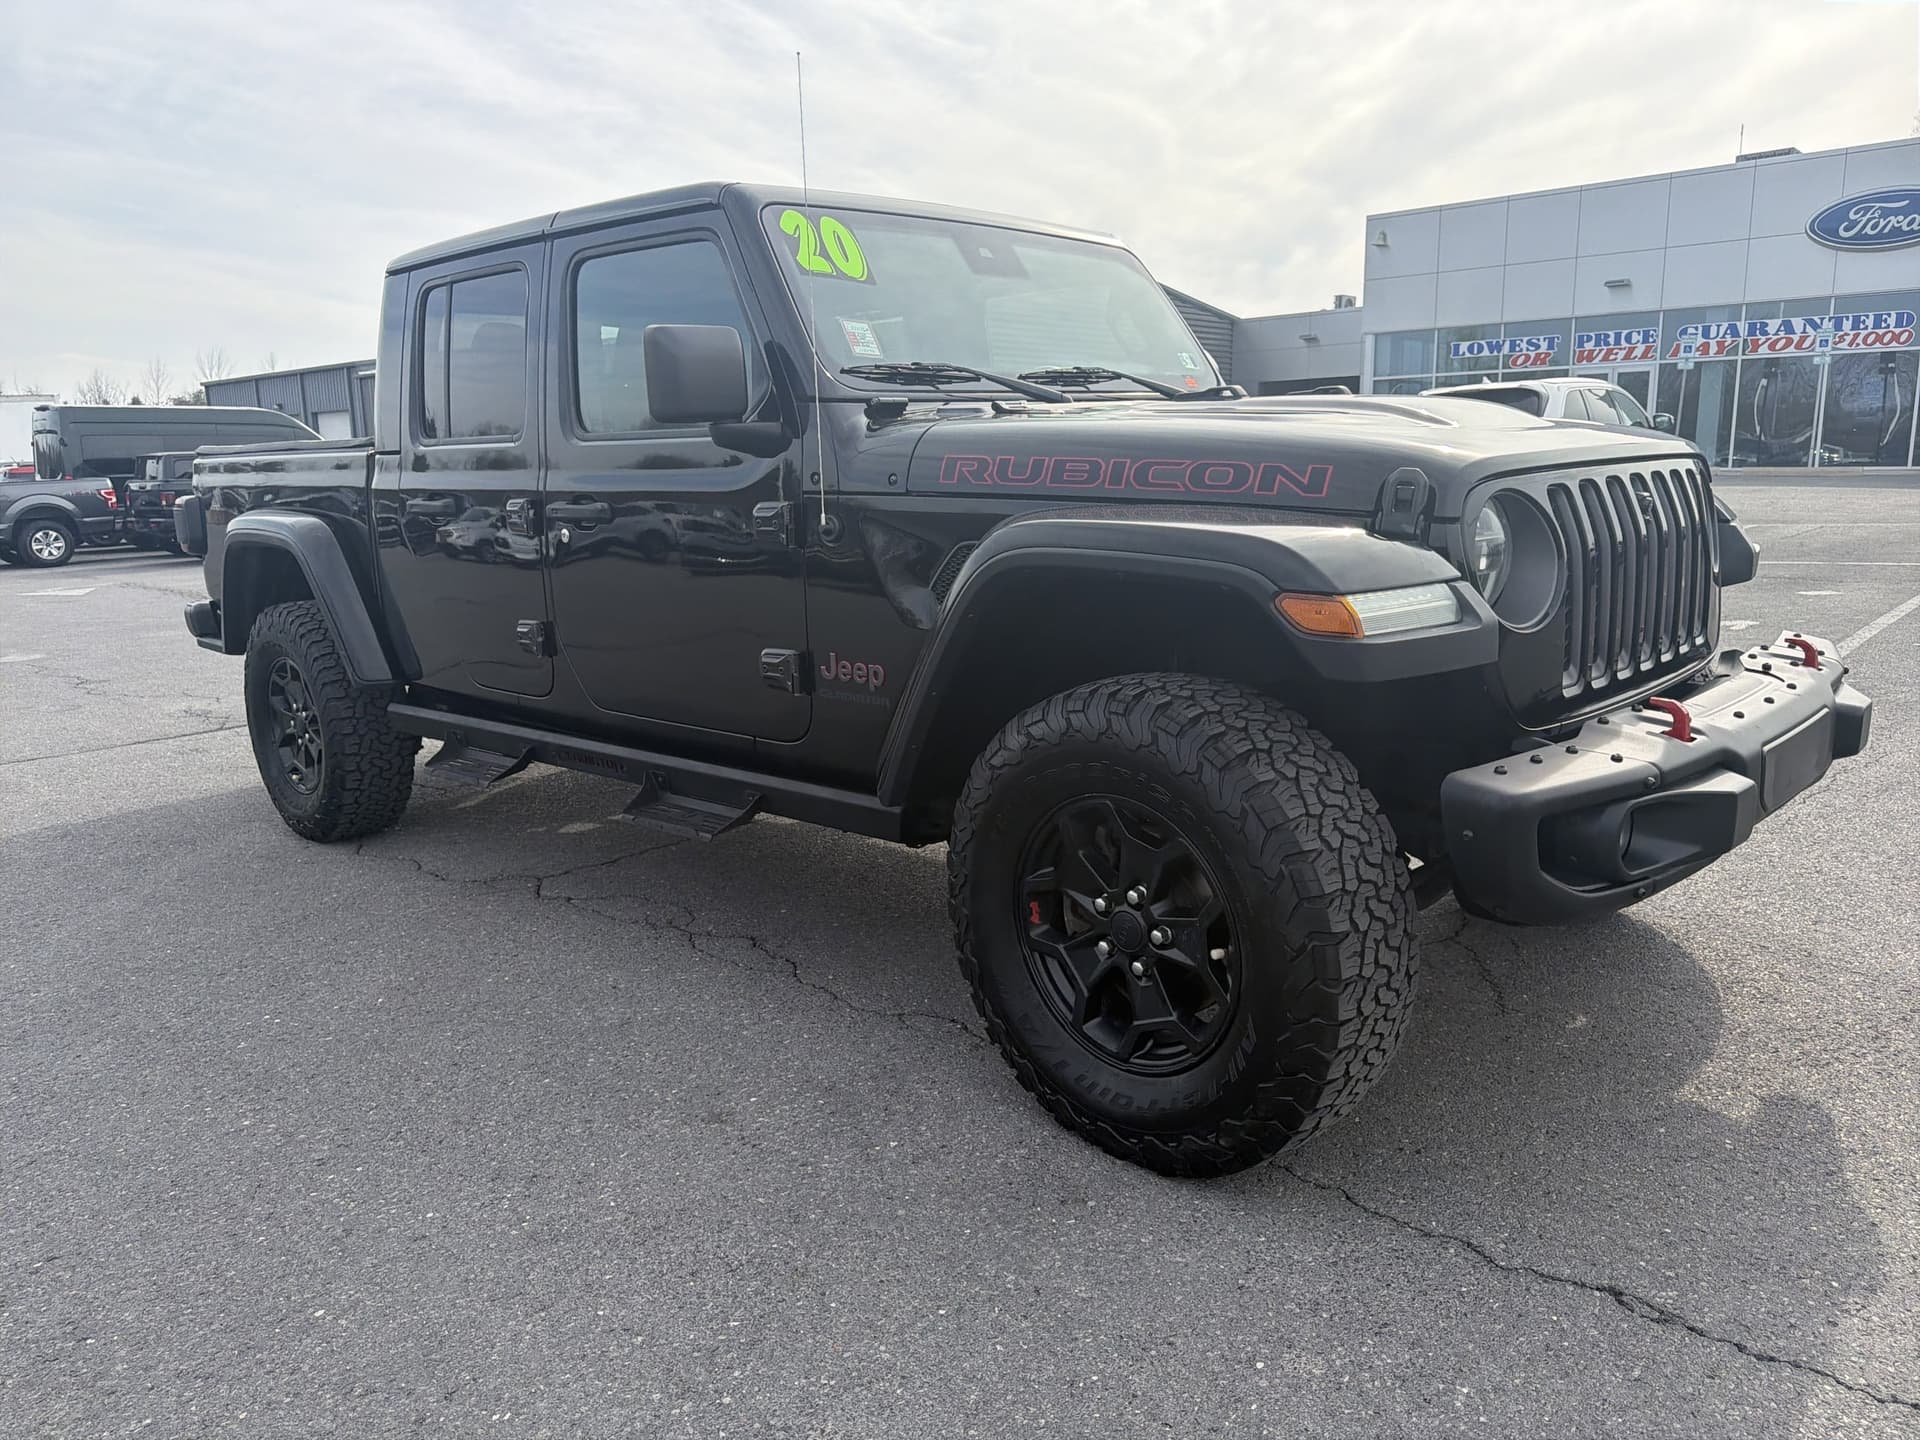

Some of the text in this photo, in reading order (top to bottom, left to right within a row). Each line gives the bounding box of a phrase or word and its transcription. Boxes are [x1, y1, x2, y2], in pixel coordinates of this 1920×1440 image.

[779, 209, 868, 281] 20
[1450, 310, 1917, 358] LOWEST PRICE GUARANTEED
[1509, 350, 1553, 368] OR
[1745, 334, 1817, 354] YOU
[1832, 328, 1915, 348] $1,000
[937, 454, 1333, 497] RUBICON
[819, 651, 886, 692] Jeep
